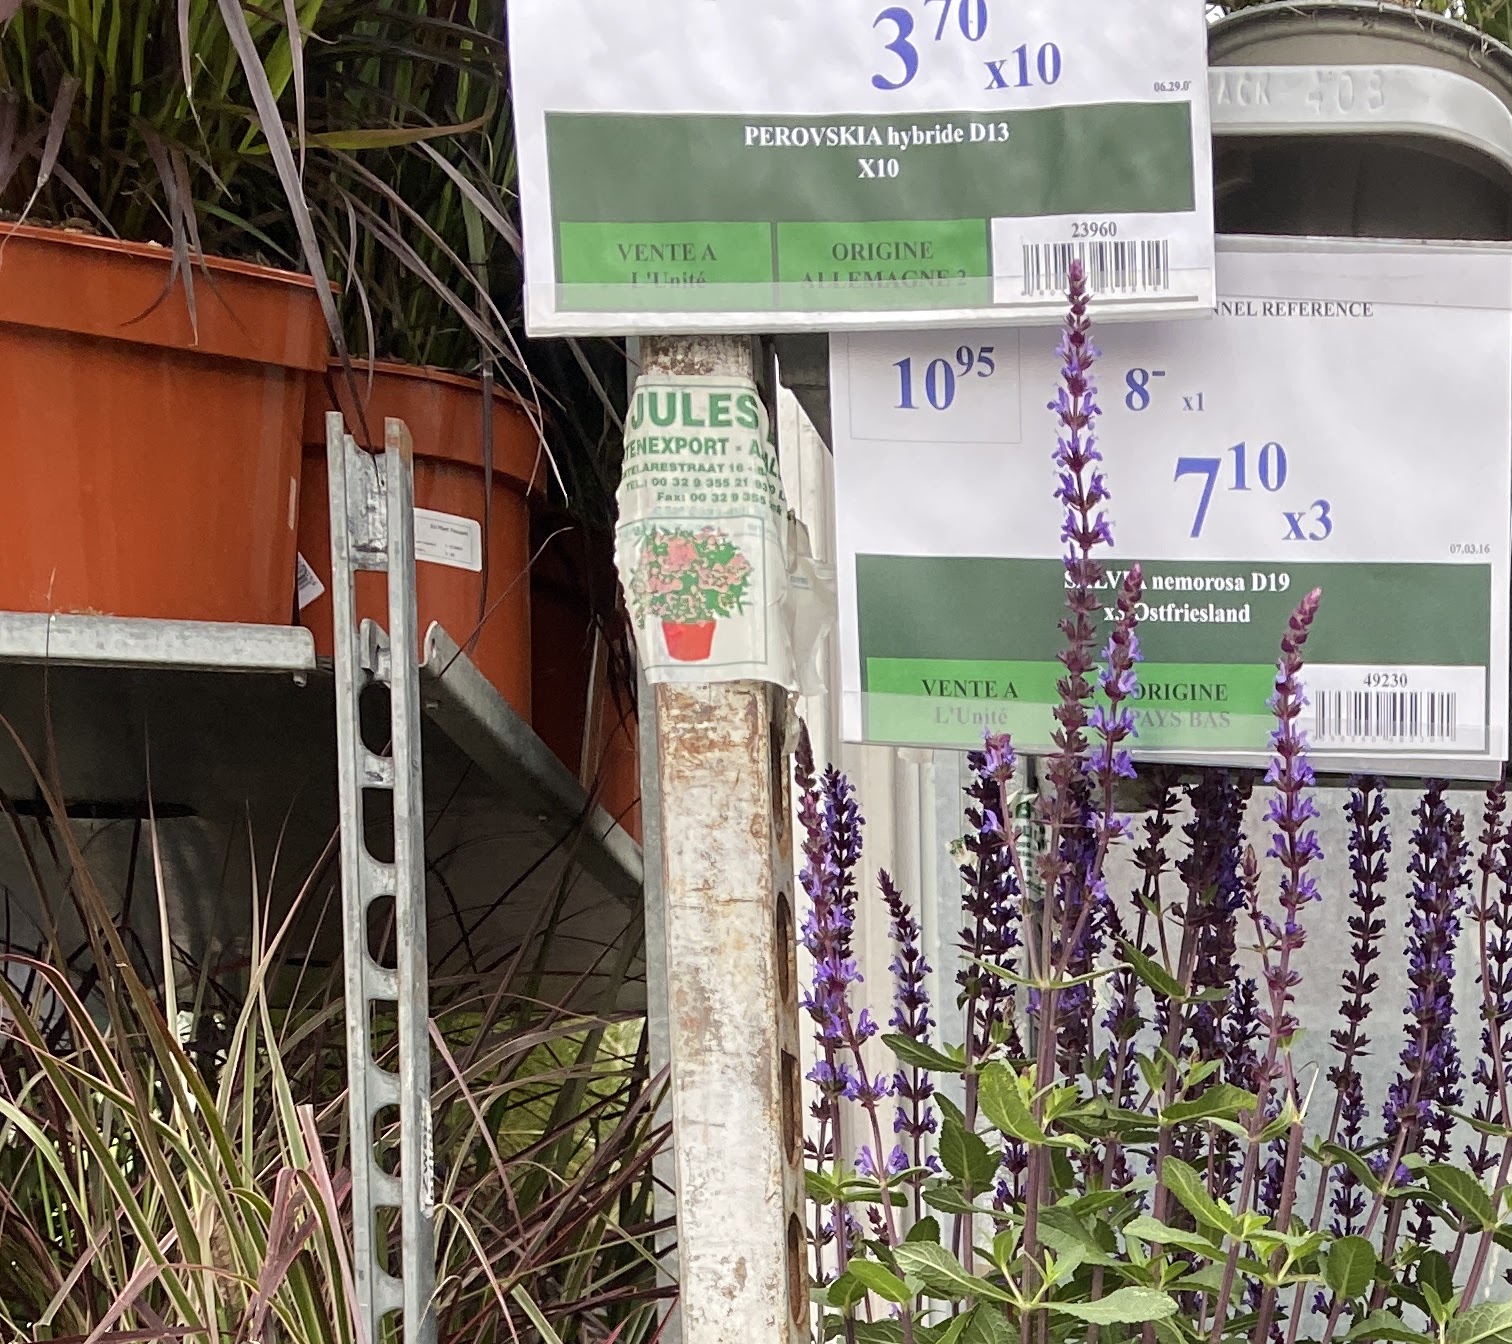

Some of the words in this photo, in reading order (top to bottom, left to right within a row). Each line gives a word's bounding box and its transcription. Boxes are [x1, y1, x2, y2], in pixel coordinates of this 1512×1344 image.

[984, 43, 1061, 90] x10
[745, 124, 883, 147] PEROVSKIA
[886, 122, 964, 150] hybride
[969, 123, 1009, 143] D13
[859, 158, 899, 178] X10
[1071, 222, 1117, 238] 23960
[617, 243, 695, 261] VENTE
[700, 242, 716, 261] A
[831, 241, 934, 261] ORIGINE
[1263, 302, 1373, 317] REFERENCE
[631, 392, 759, 430] JULES
[1181, 392, 1205, 412] x1
[1282, 499, 1333, 541] x3
[1450, 543, 1491, 555] 07.03.16
[1152, 576, 1245, 591] nemorosa
[1251, 573, 1290, 591] D19
[922, 679, 997, 698] VENTE
[1004, 681, 1018, 698] A
[1364, 673, 1408, 687] 49230
[935, 706, 1007, 725] L'Unité
[1189, 711, 1230, 728] BAS
